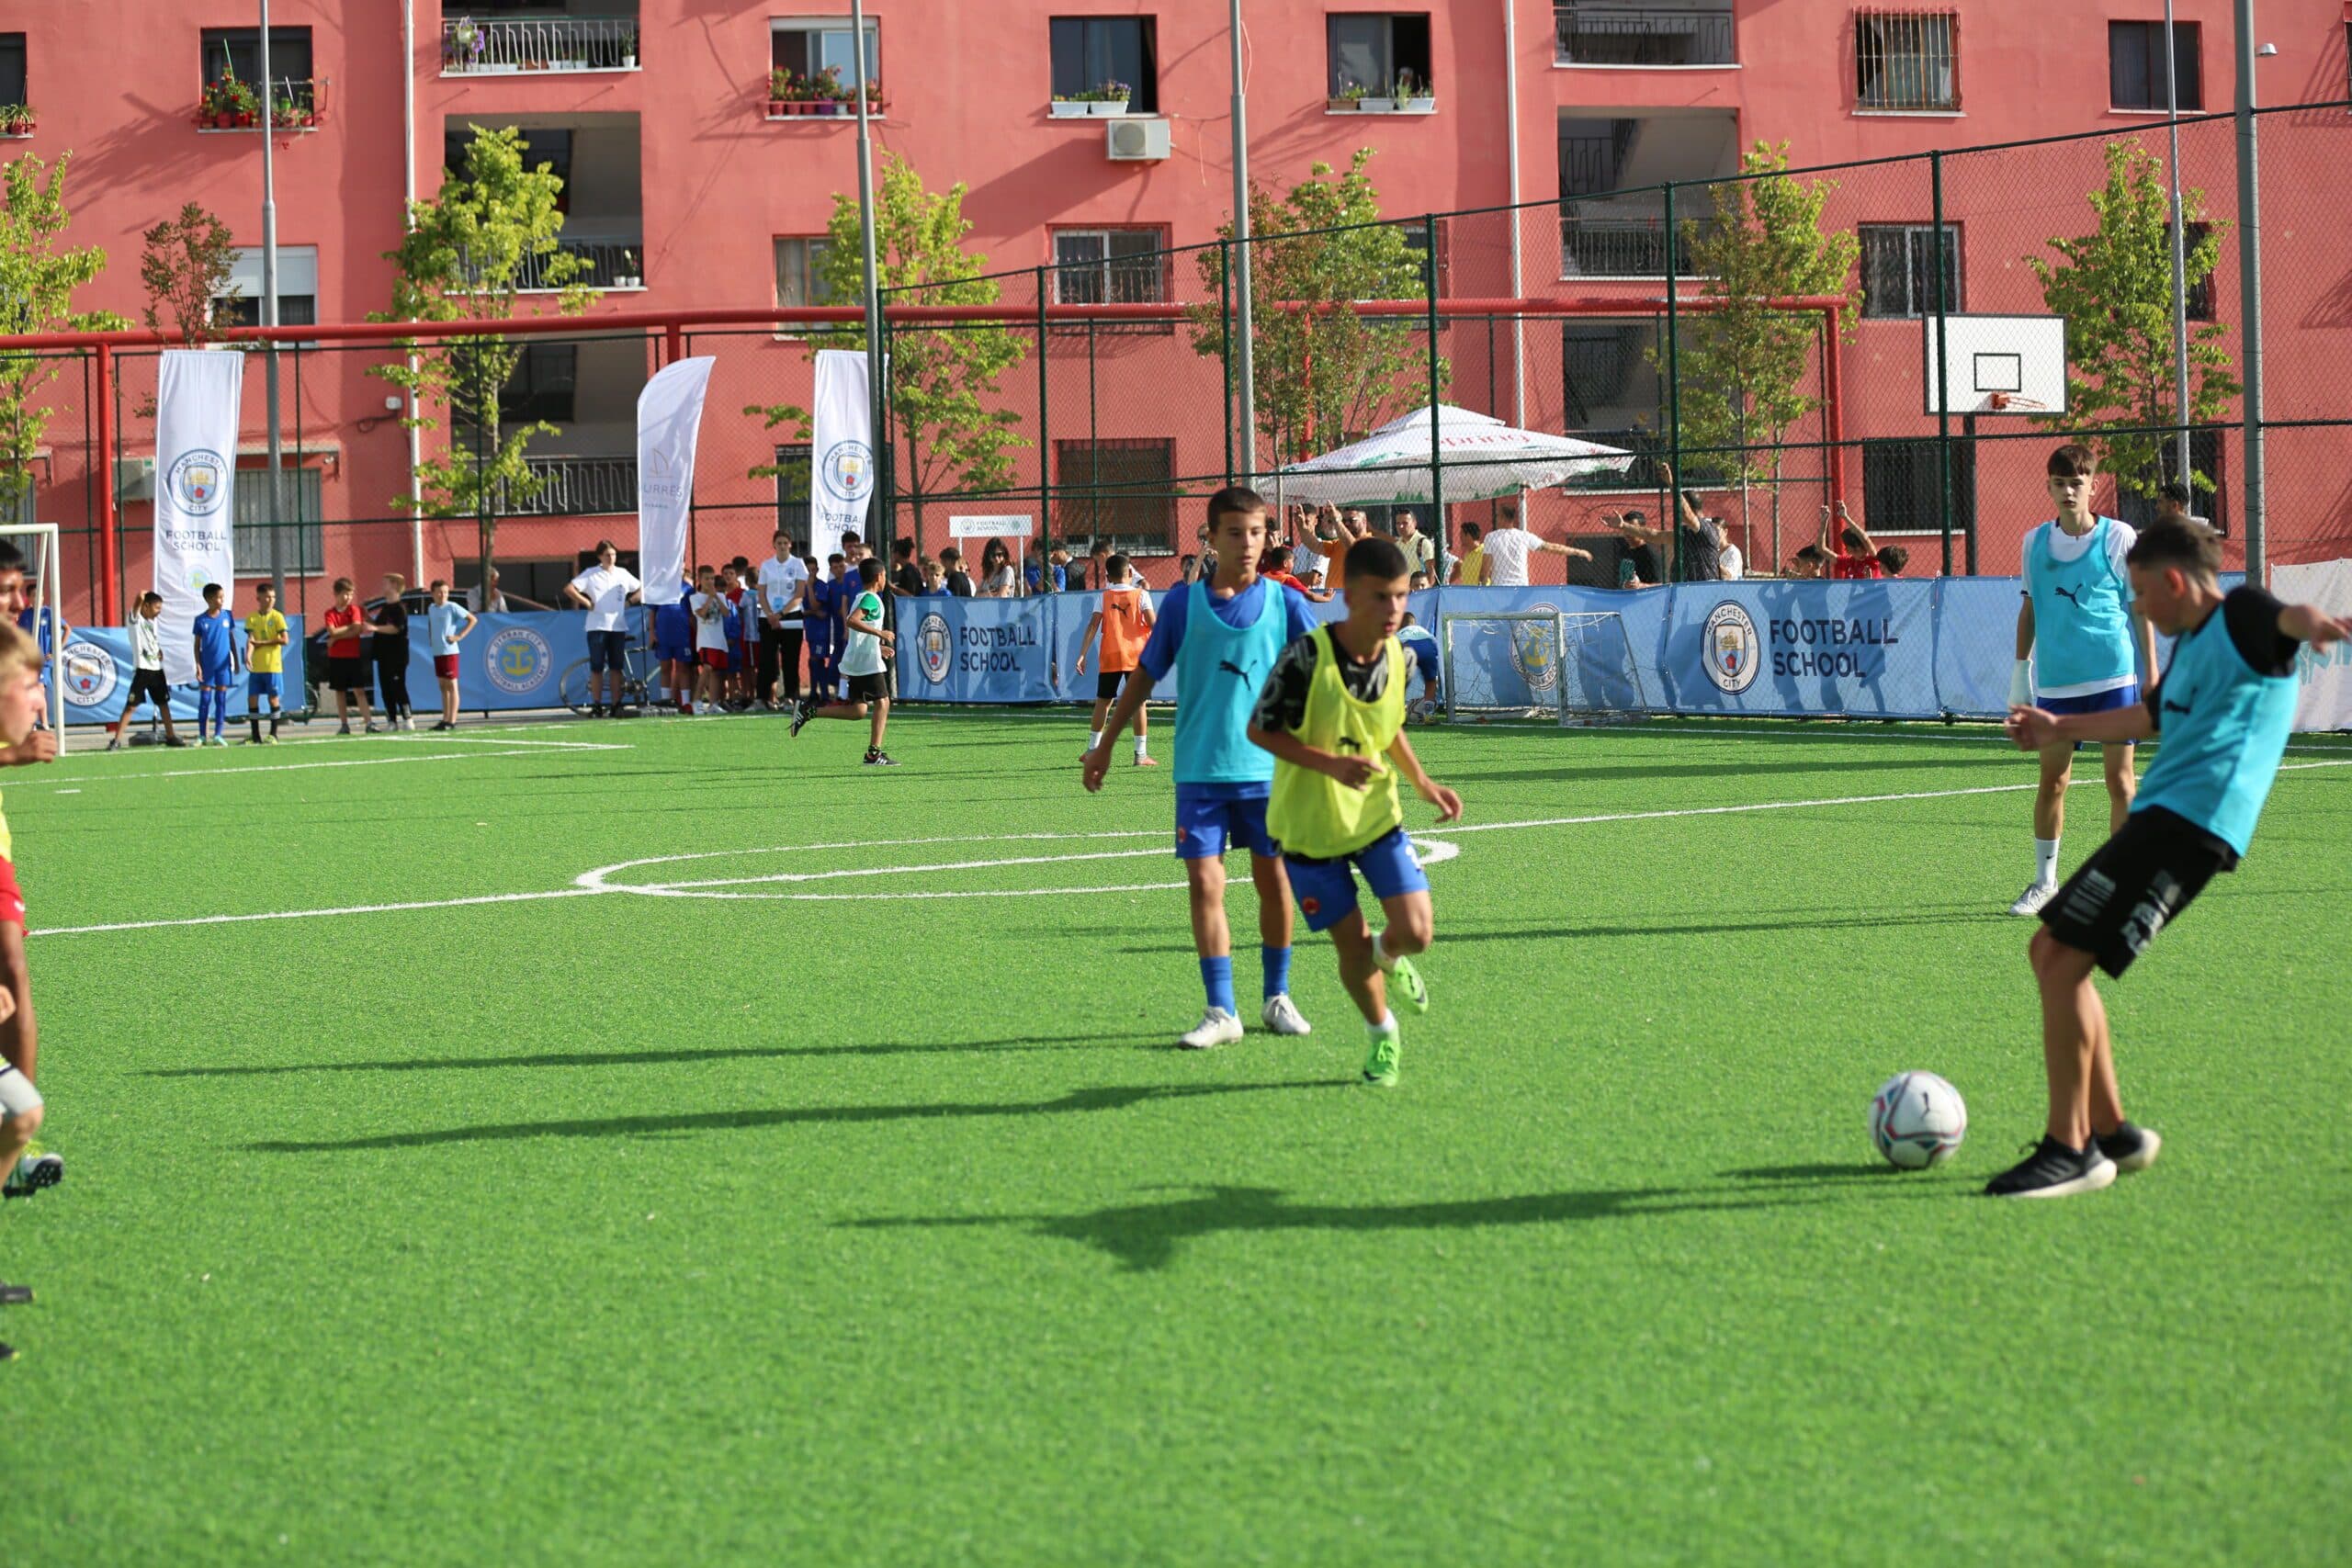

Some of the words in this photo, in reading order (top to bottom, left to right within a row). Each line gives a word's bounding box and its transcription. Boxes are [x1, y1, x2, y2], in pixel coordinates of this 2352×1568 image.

[165, 530, 228, 541] FOOTBALL
[173, 541, 221, 551] SCHOOL
[1706, 606, 1753, 636] MANCHESTER
[1770, 618, 1899, 644] FOOTBALL
[960, 626, 1036, 647] FOOTBALL
[960, 651, 1022, 671] SCHOOL
[1772, 651, 1867, 677] SCHOOL
[1723, 679, 1741, 688] CITY
[76, 695, 96, 704] CITY
